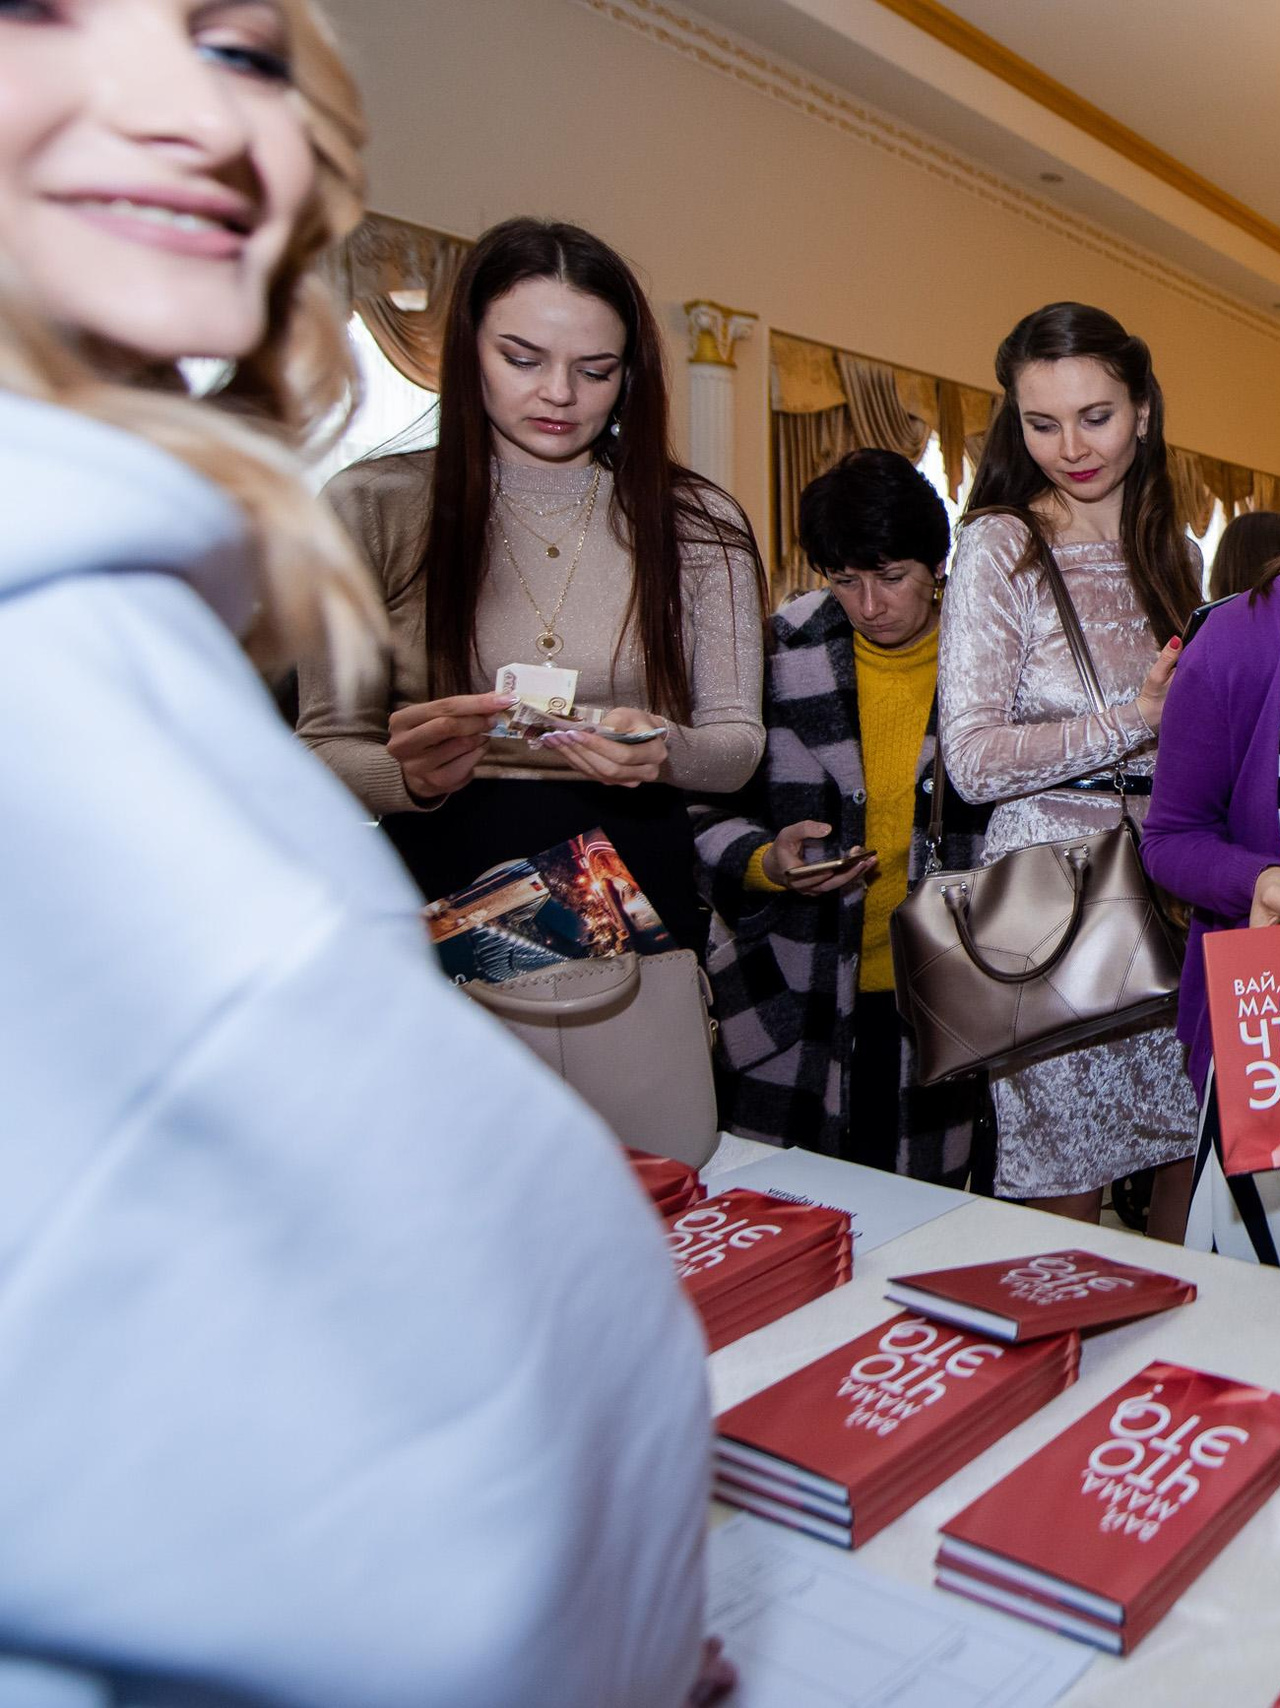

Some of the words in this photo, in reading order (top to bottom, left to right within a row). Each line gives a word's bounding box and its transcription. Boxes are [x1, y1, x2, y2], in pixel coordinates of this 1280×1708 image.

[1234, 970, 1280, 996] ВАЙ,
[673, 1201, 782, 1249] ЭТО?
[878, 1317, 1005, 1378] ЭТО?
[836, 1375, 924, 1421] МАМА,
[849, 1353, 947, 1407] ЧТО
[1109, 1383, 1250, 1470] ЭТО?
[1081, 1468, 1183, 1522] МАМА,
[1088, 1437, 1200, 1505] ЧТО
[1099, 1500, 1161, 1543] ВАЙ,
